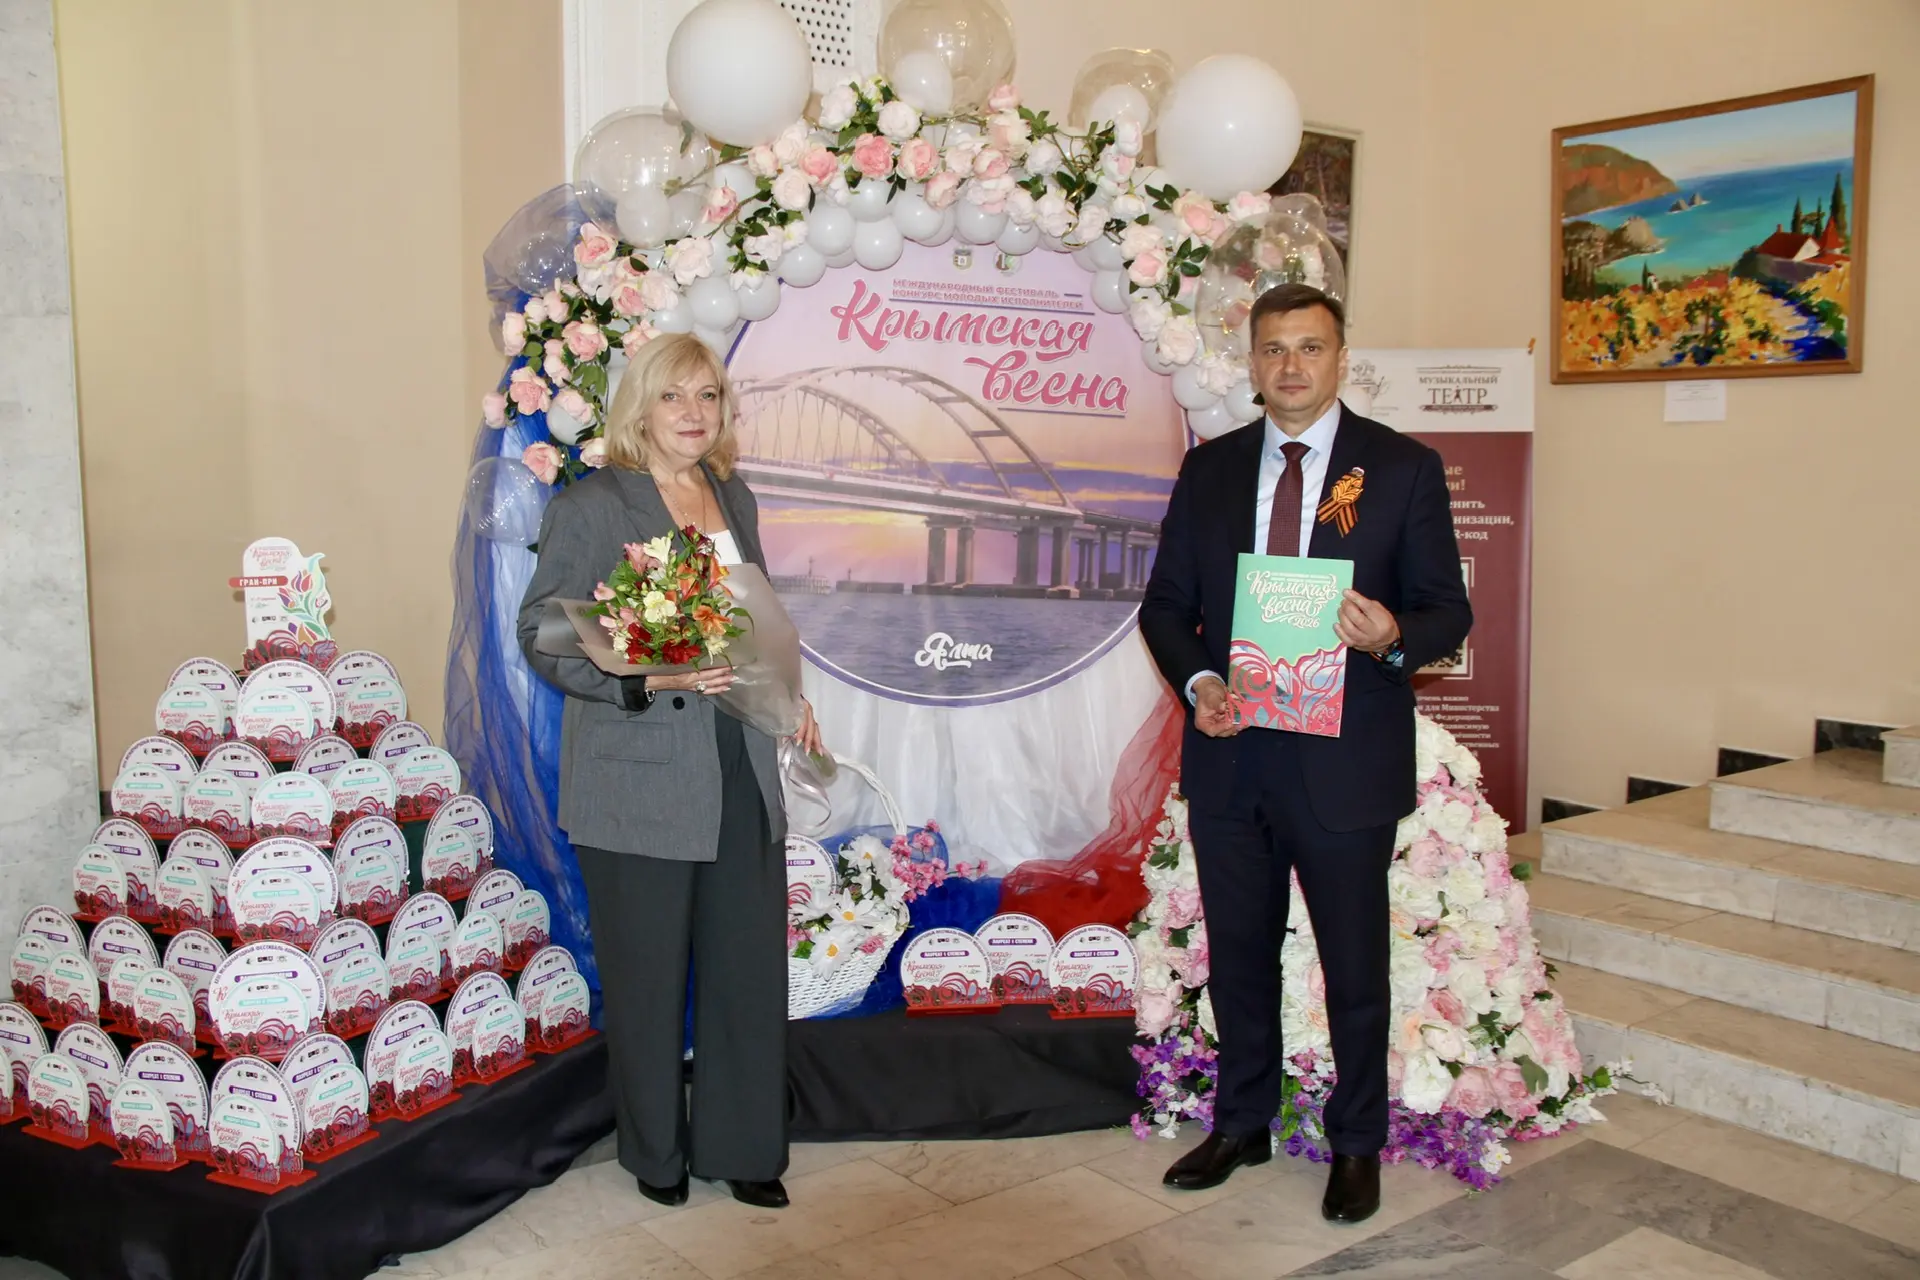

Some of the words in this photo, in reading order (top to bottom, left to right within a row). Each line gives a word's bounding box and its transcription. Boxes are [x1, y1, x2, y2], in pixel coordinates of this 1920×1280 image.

[893, 279, 993, 294] МЕЖДУНАРОДНЫЙ
[996, 286, 1059, 299] ФЕСТИВАЛЬ
[892, 289, 942, 300] КОНКУРС
[943, 292, 999, 303] МОЛОДЫХ
[1001, 296, 1084, 310] ИСПОЛНИТЕЛЕЙ
[830, 278, 1095, 362] Крымская
[963, 349, 1130, 411] весна
[1419, 376, 1498, 385] МУЗЫКАЛЬНЫЙ
[1428, 386, 1488, 405] ТЕАТР
[1453, 515, 1514, 526] низации,
[239, 578, 278, 586] ГРАН-ПРИ
[1247, 570, 1339, 604] Крымская
[1293, 616, 1320, 629] 2026
[914, 631, 994, 671] Ялта
